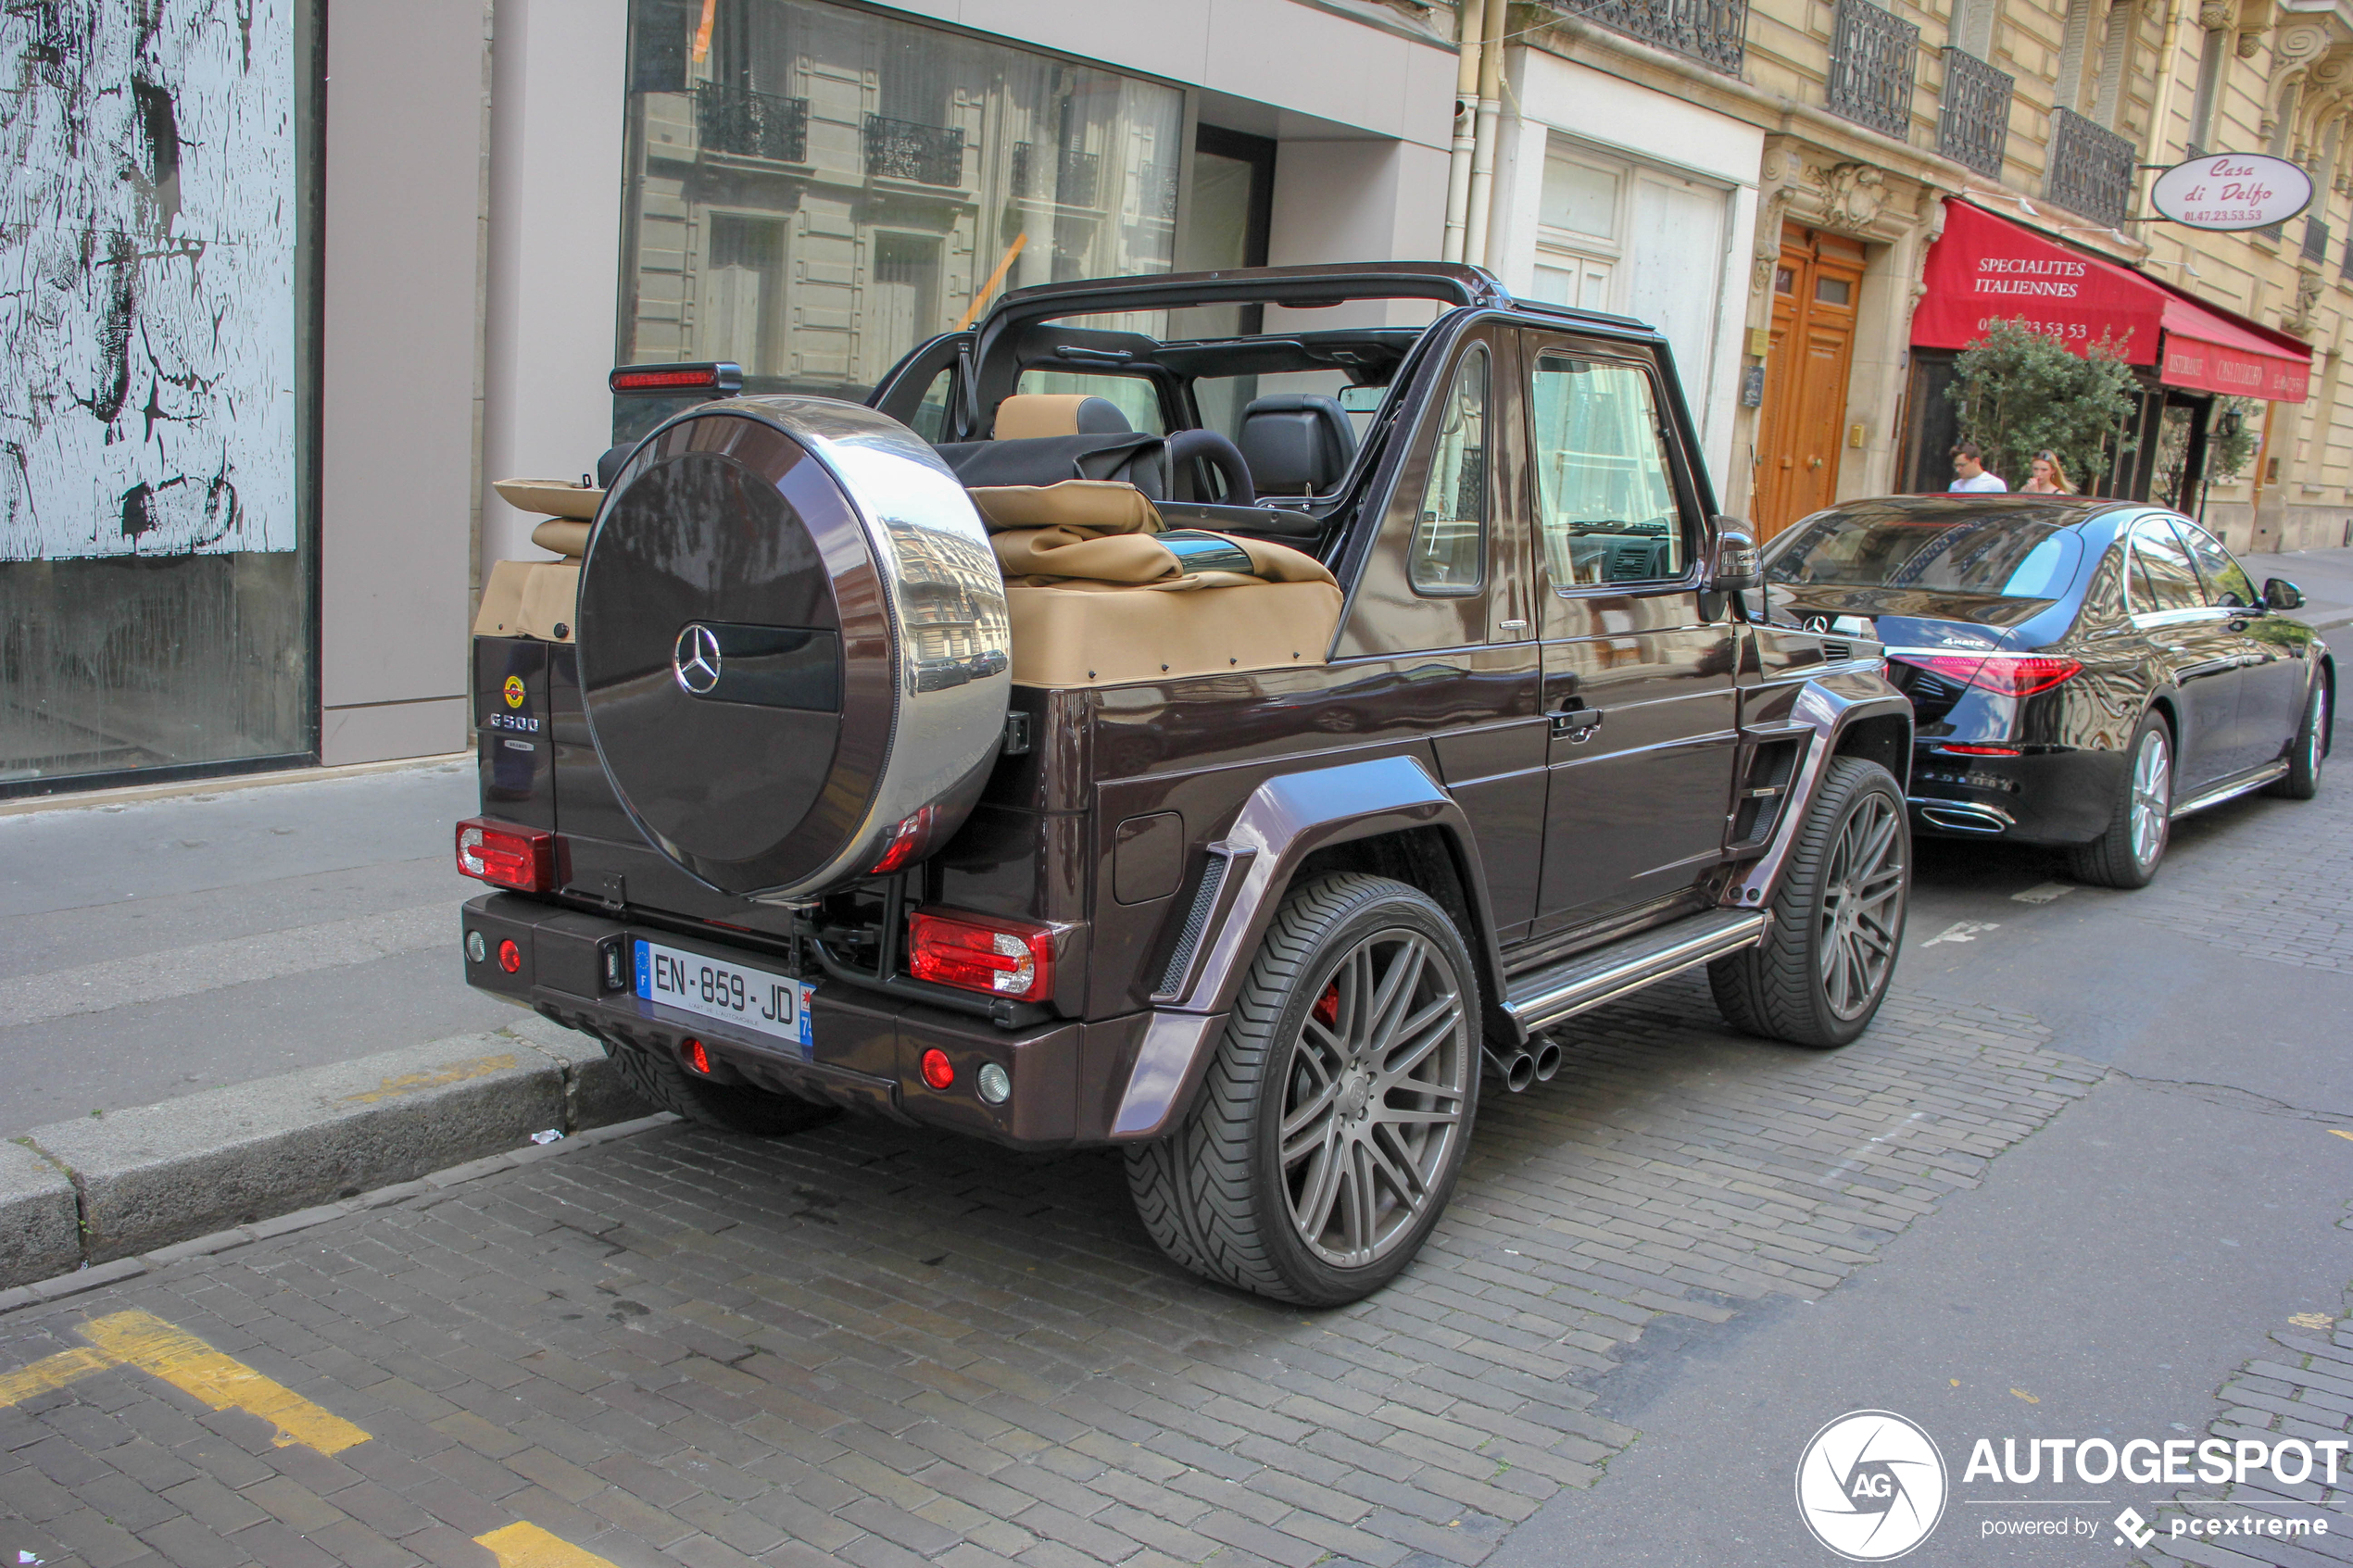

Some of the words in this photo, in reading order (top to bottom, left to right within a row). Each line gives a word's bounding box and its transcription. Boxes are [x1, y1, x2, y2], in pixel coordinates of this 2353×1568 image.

[2209, 158, 2255, 177] Casa
[2184, 185, 2206, 201] di
[2221, 182, 2272, 207] Delfo
[2184, 209, 2262, 221] 01.47.23.53.53
[1978, 257, 2087, 277] SPECIALITES
[1974, 279, 2078, 298] ITALIENNES
[2023, 320, 2041, 334] 23
[2045, 322, 2064, 337] 53
[2068, 324, 2087, 339] 53
[1942, 637, 1986, 647] 4MATIC
[490, 712, 501, 727] G
[503, 714, 540, 733] 500
[641, 975, 646, 986] F
